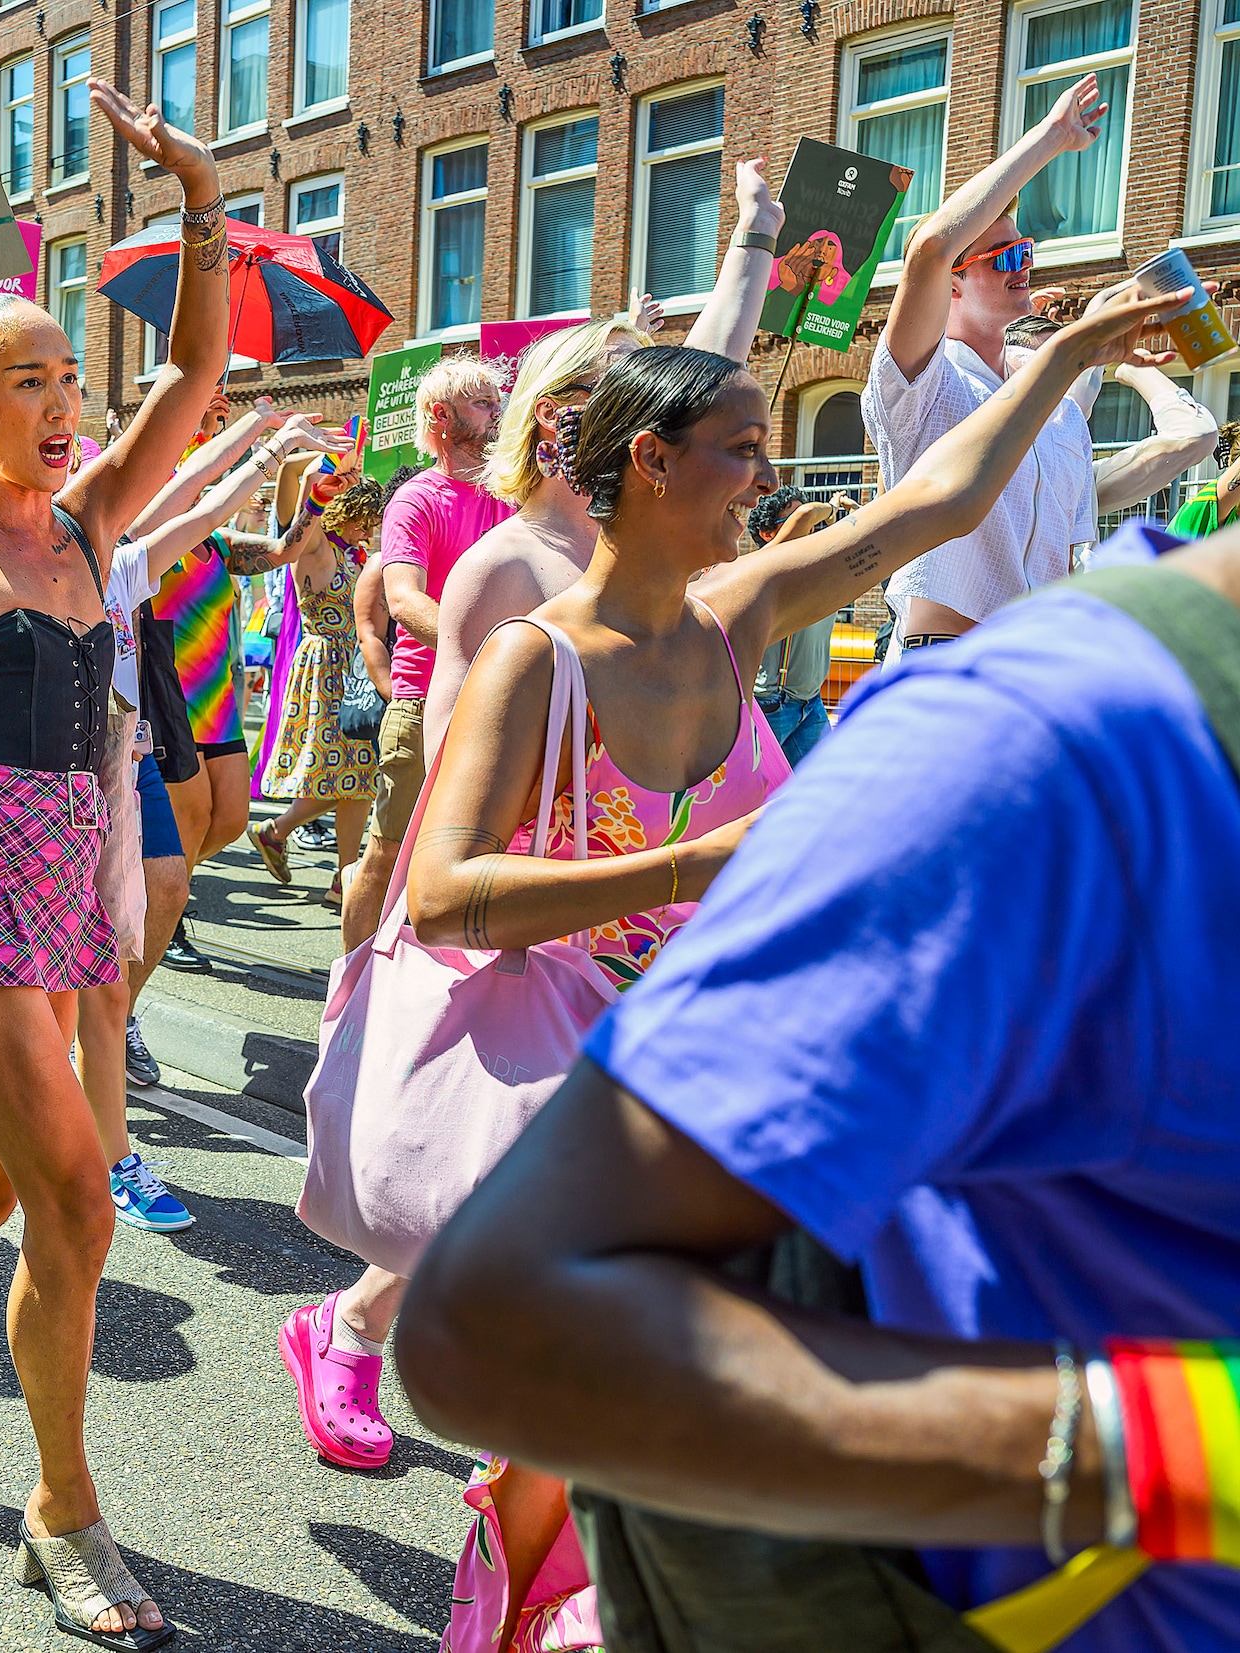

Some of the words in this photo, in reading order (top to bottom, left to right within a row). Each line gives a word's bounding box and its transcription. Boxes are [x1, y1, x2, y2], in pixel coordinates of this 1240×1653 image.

[803, 321, 843, 339] GELIJKHEID
[806, 311, 831, 326] STRIJD
[831, 319, 850, 331] VOOR
[400, 366, 412, 380] IK
[375, 398, 389, 413] ME
[390, 392, 405, 408] UIT
[376, 409, 417, 430] GELIJKHE
[378, 434, 390, 448] EN
[392, 428, 416, 444] VRED
